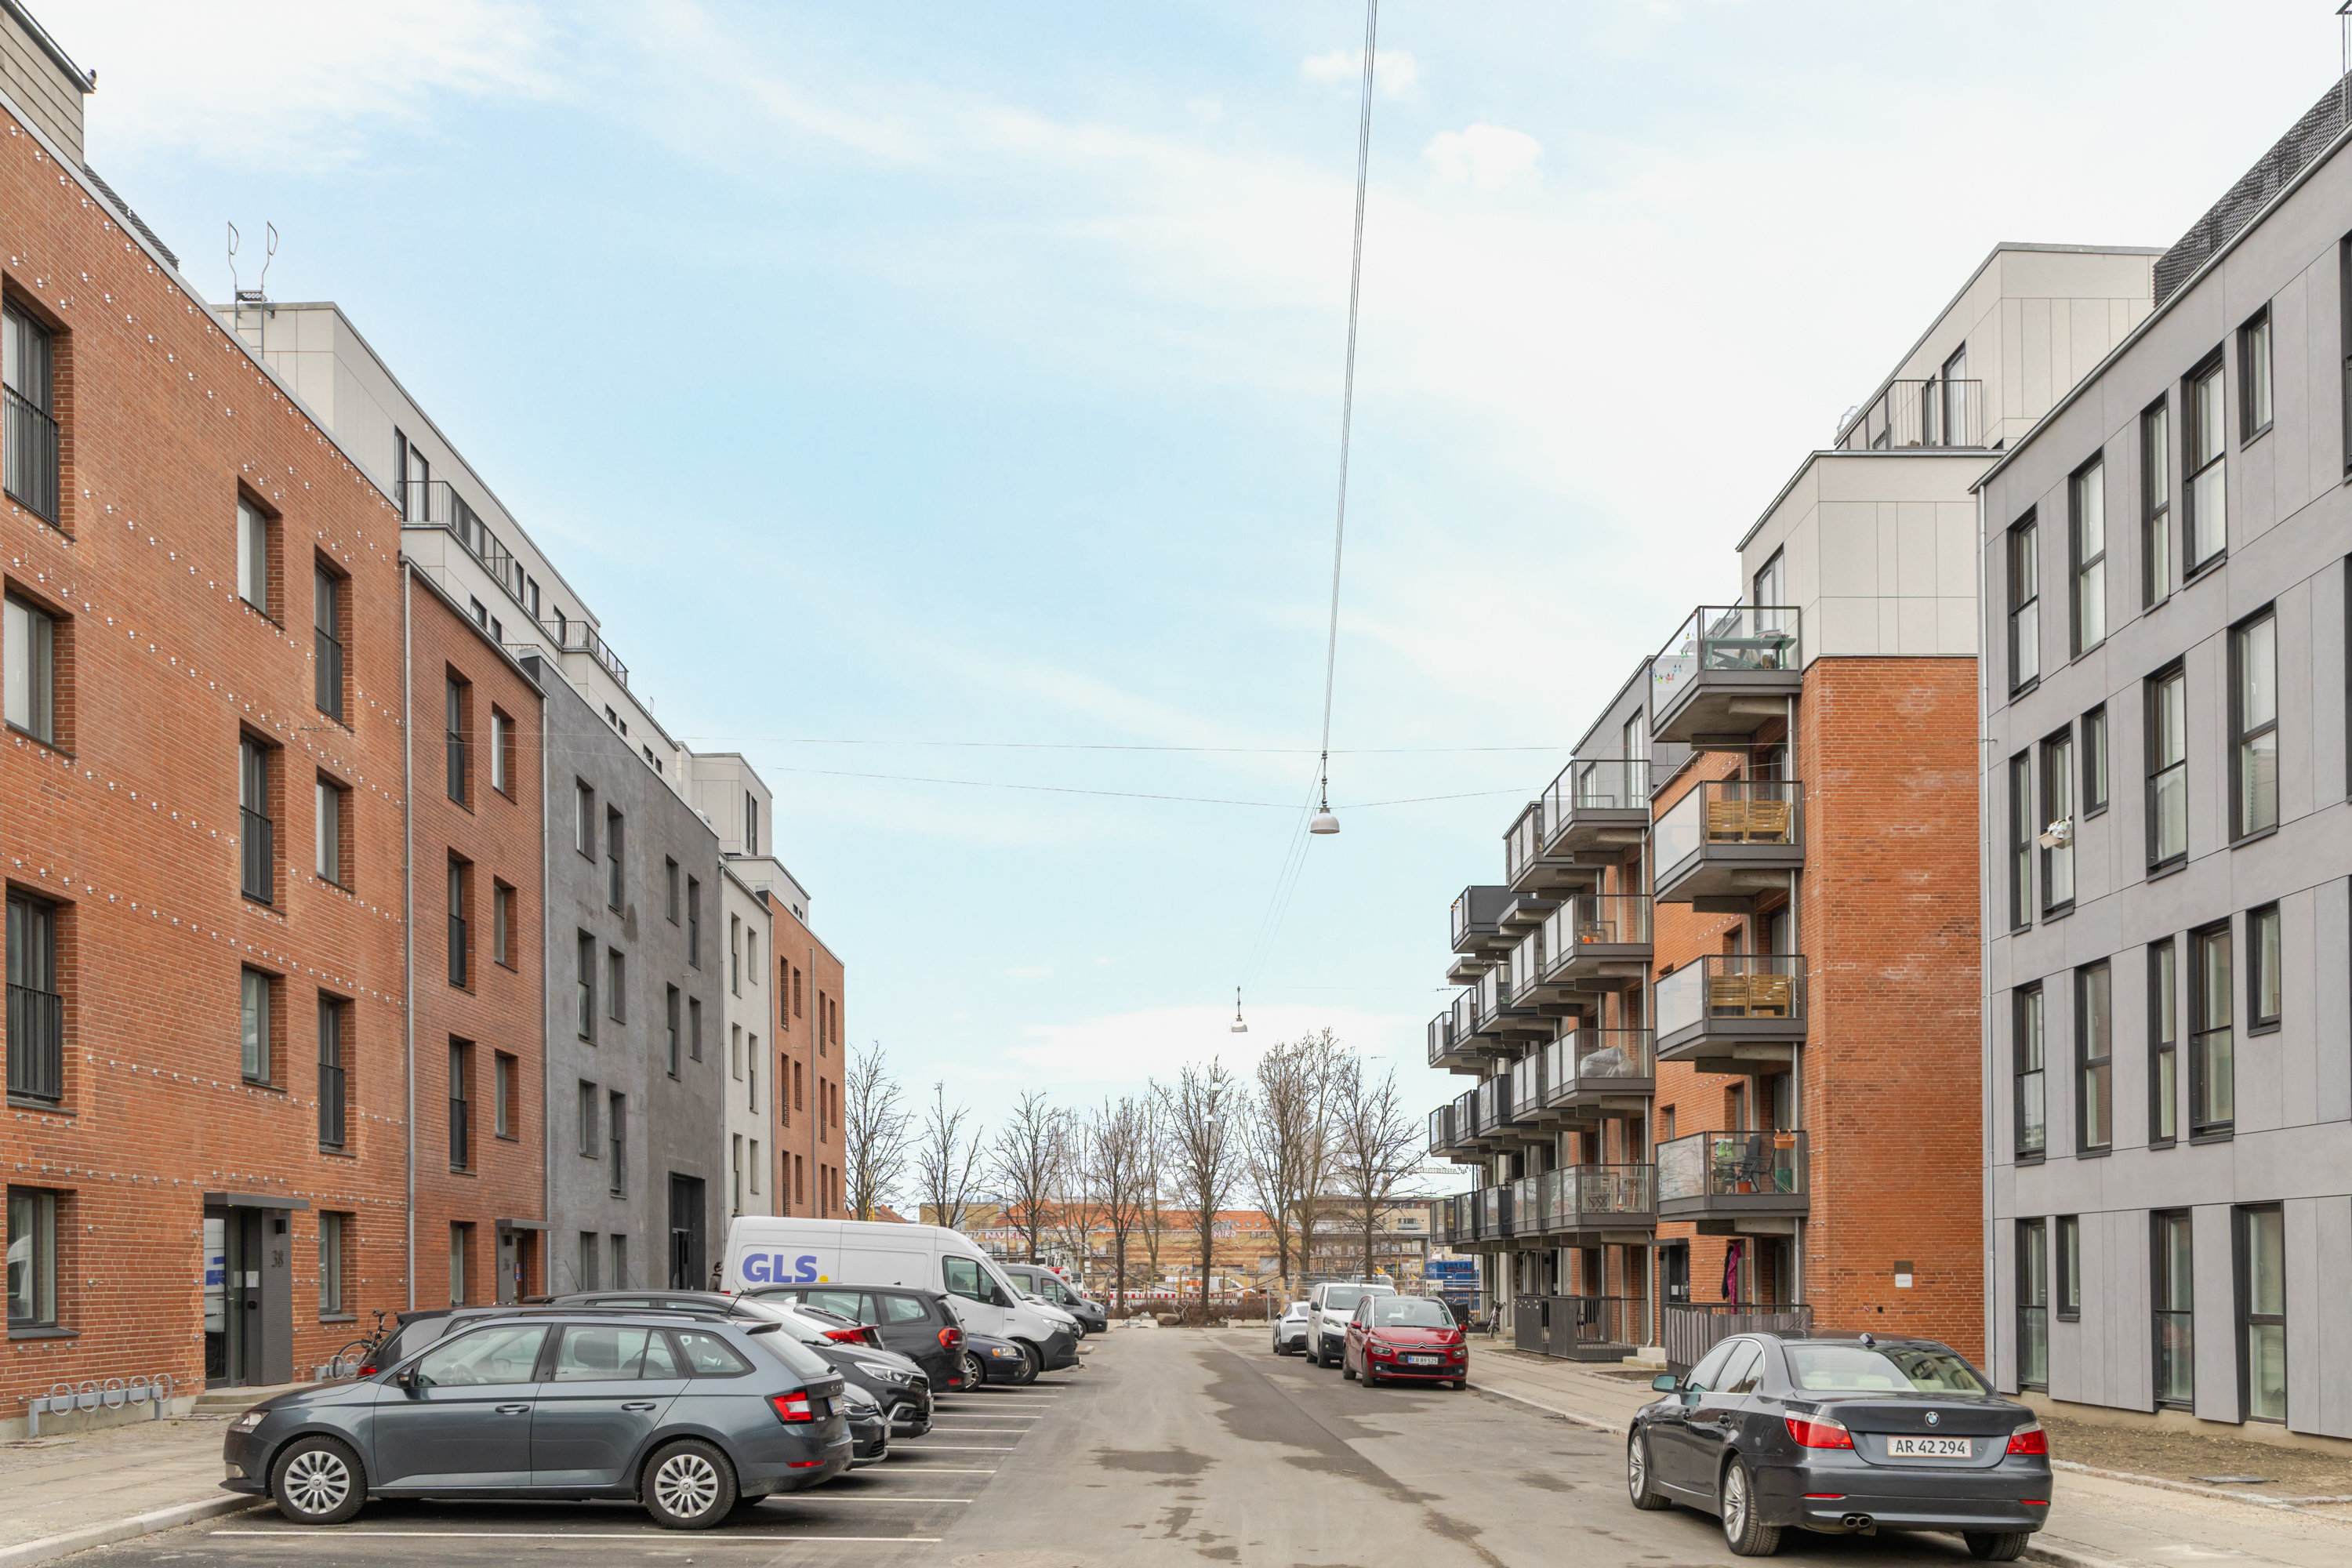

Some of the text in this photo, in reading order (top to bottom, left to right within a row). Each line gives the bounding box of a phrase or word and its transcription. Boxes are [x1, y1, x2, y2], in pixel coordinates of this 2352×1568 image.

[271, 1249, 285, 1268] 38
[1896, 1439, 1965, 1454] AR 42 294
